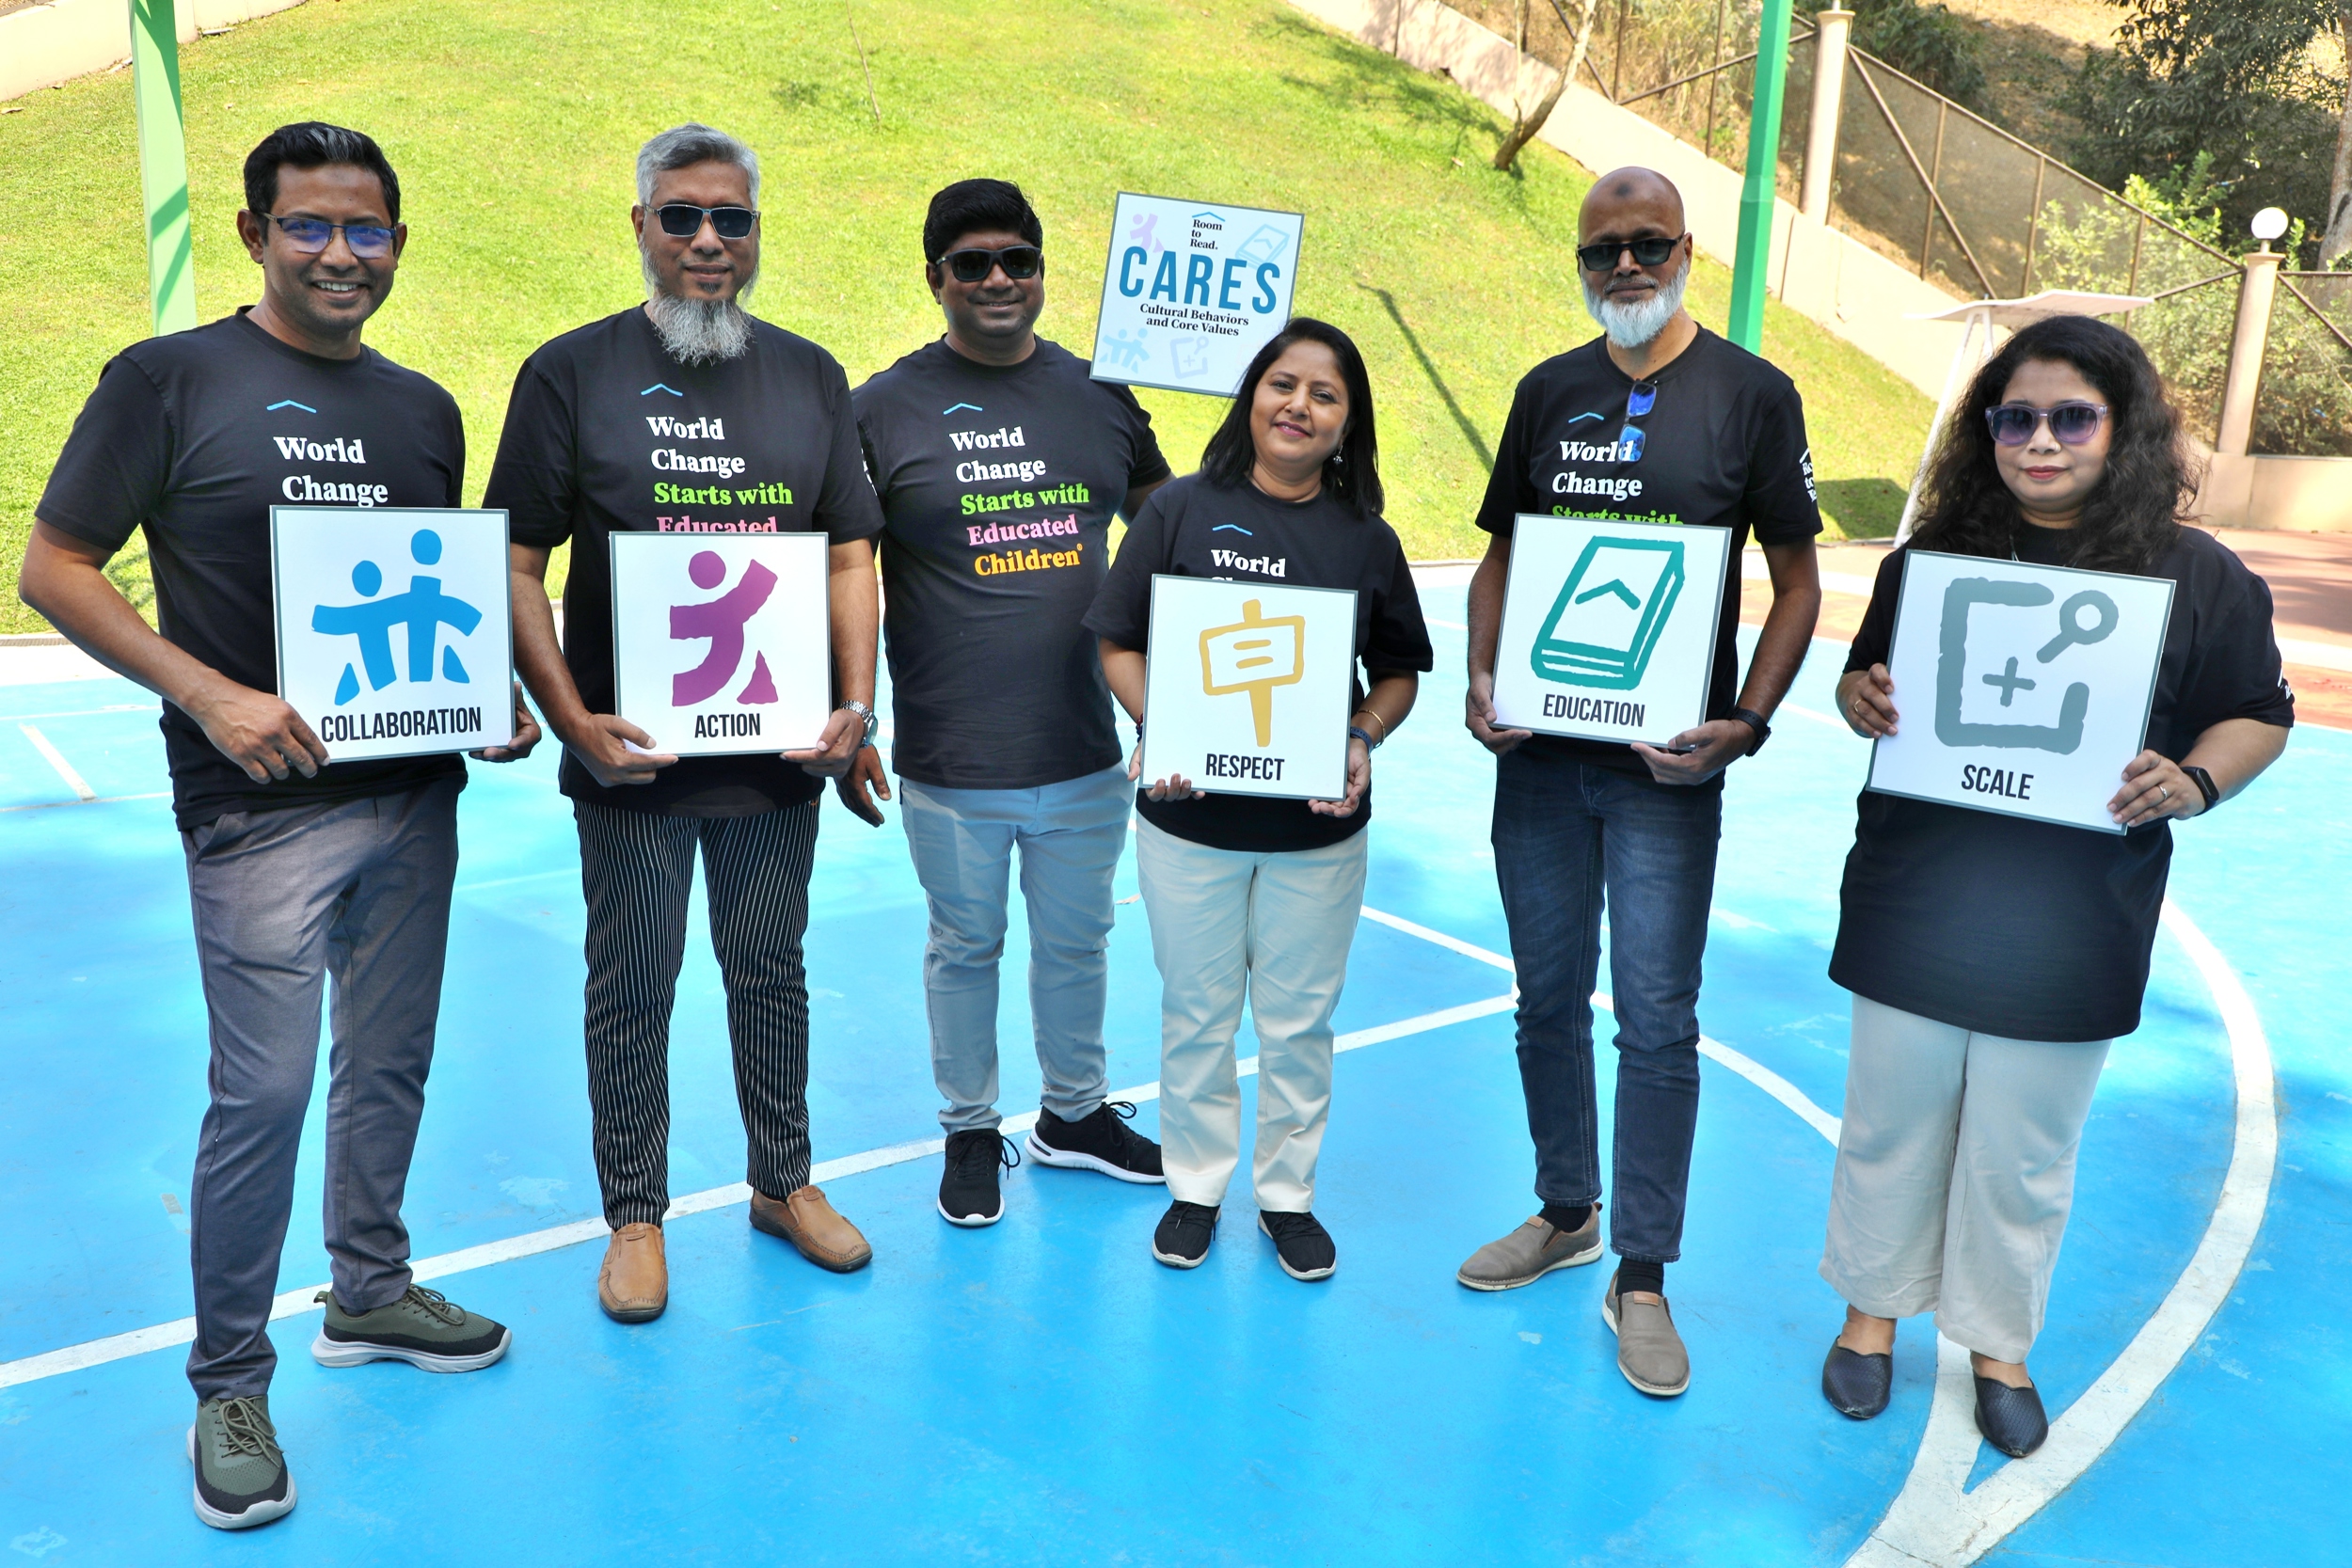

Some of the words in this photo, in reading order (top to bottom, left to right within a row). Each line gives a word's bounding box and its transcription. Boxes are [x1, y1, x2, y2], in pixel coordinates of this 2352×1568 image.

[1191, 229, 1201, 238] to
[1193, 218, 1222, 231] Room
[1119, 245, 1280, 314] CARES
[1139, 303, 1188, 319] Cultural
[1190, 309, 1249, 325] Behaviors
[1146, 317, 1169, 328] and
[1170, 319, 1199, 331] Core
[1201, 322, 1239, 336] Values
[646, 416, 725, 441] World
[948, 425, 1026, 451] World
[273, 436, 367, 464] World
[650, 448, 746, 479] Change
[1559, 439, 1634, 462] World
[955, 458, 1047, 483] Change
[281, 474, 389, 507] Change
[654, 482, 732, 505] Starts
[735, 482, 794, 506] with
[961, 489, 1035, 515] Starts
[1038, 483, 1090, 506] with
[1551, 470, 1643, 501] Change
[966, 514, 1079, 546] Educated
[1210, 548, 1286, 578] World
[321, 706, 483, 742] COLLABORATION
[1542, 693, 1645, 728] EDUCATION
[694, 713, 761, 737] ACTION
[1205, 753, 1285, 781] RESPECT
[1961, 764, 2034, 801] SCALE
